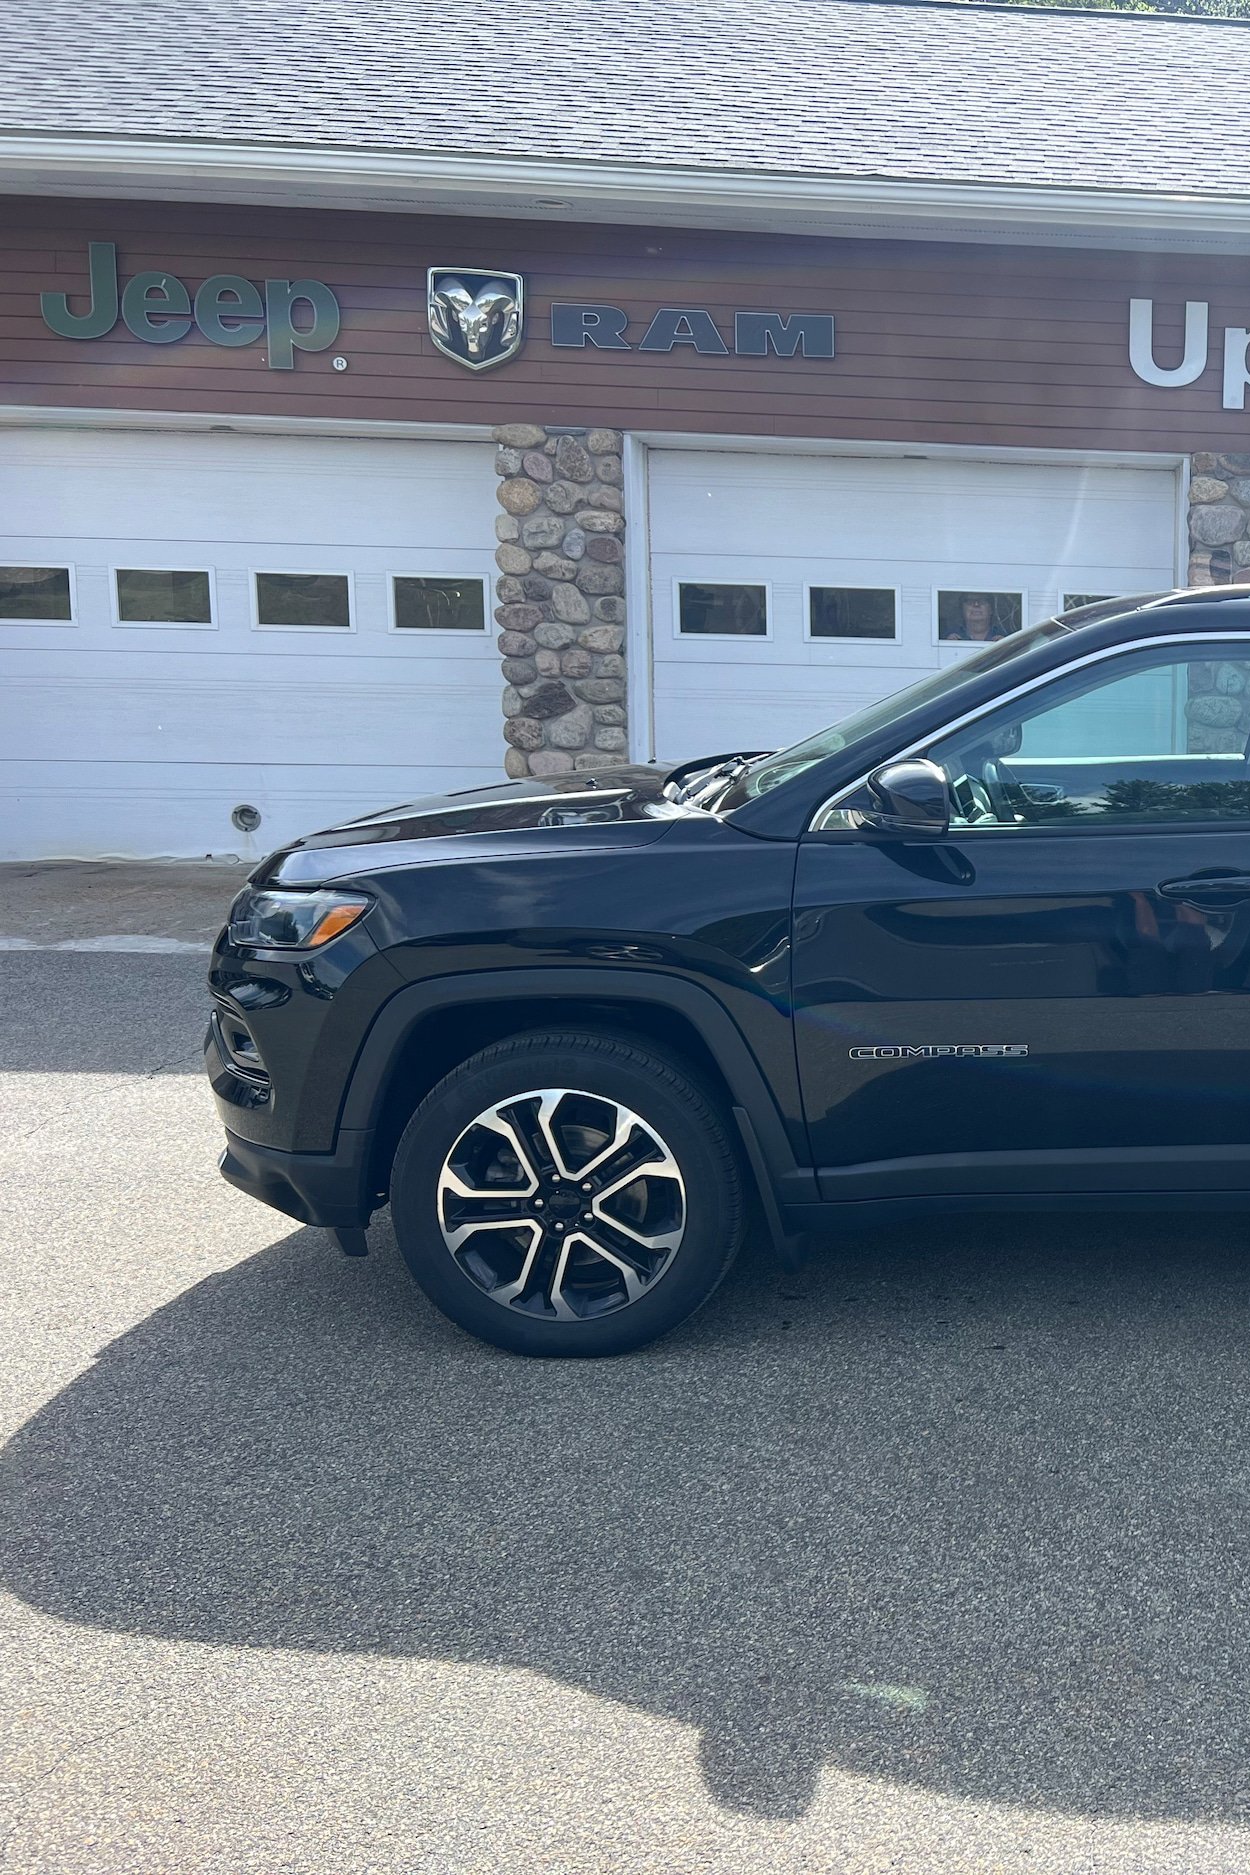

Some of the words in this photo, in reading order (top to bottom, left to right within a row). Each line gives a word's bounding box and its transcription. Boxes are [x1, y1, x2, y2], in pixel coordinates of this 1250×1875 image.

[40, 241, 341, 371] Jeep
[550, 302, 836, 359] RAM
[849, 1044, 1029, 1060] COMPASS
